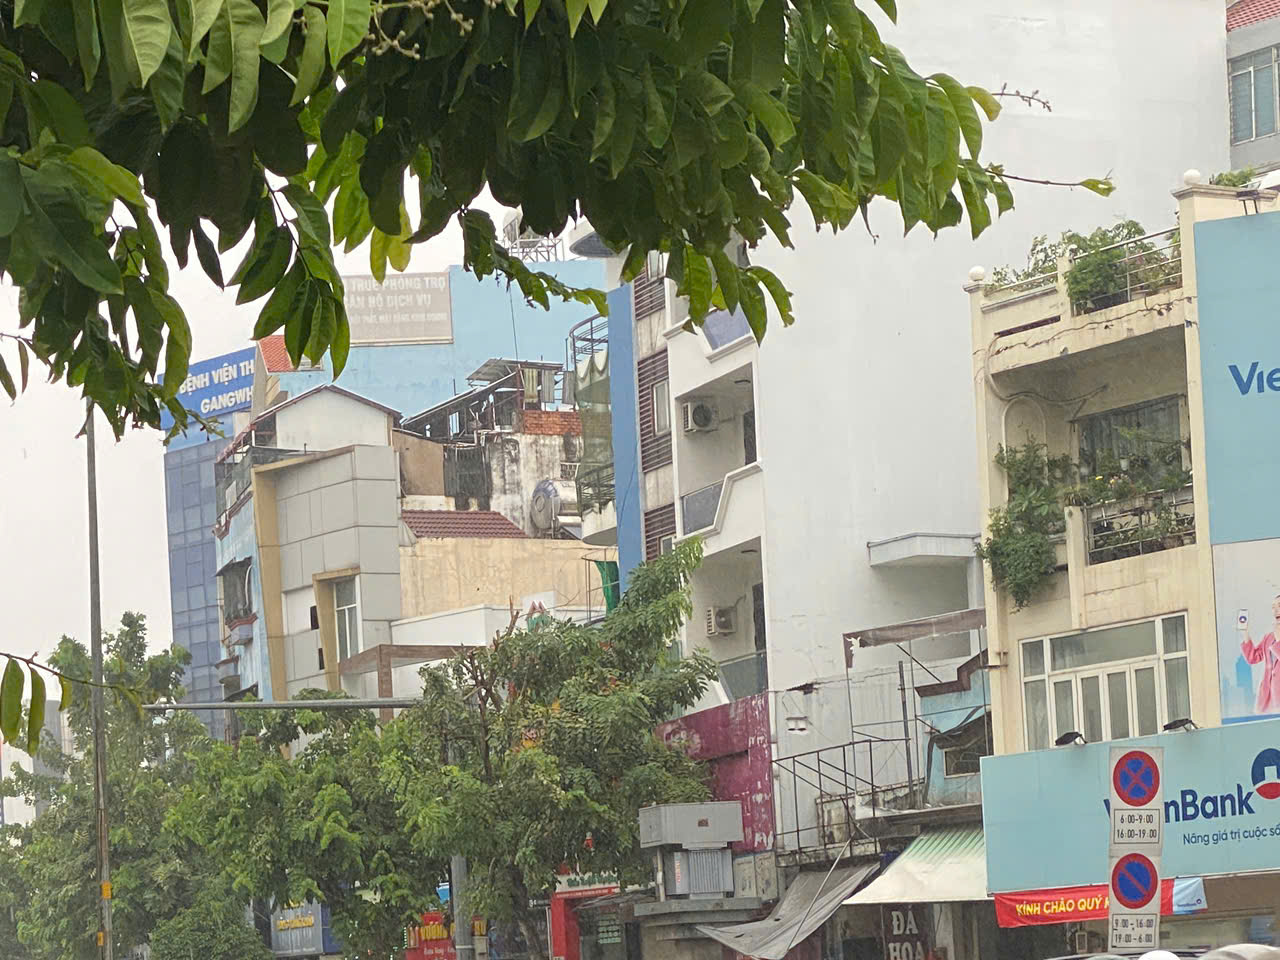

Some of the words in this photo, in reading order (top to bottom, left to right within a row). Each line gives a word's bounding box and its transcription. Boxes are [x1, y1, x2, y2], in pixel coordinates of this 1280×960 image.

[211, 362, 238, 386] VIỆN
[1228, 361, 1280, 395] Vie
[1183, 832, 1210, 846] Nâng
[1212, 829, 1228, 845] giá
[1230, 828, 1241, 843] trị
[1242, 826, 1268, 841] cuộc
[1016, 901, 1041, 916] KÍNH
[1043, 897, 1075, 914] CHÀO
[1077, 894, 1103, 911] QUÝ
[888, 942, 925, 960] HOA
